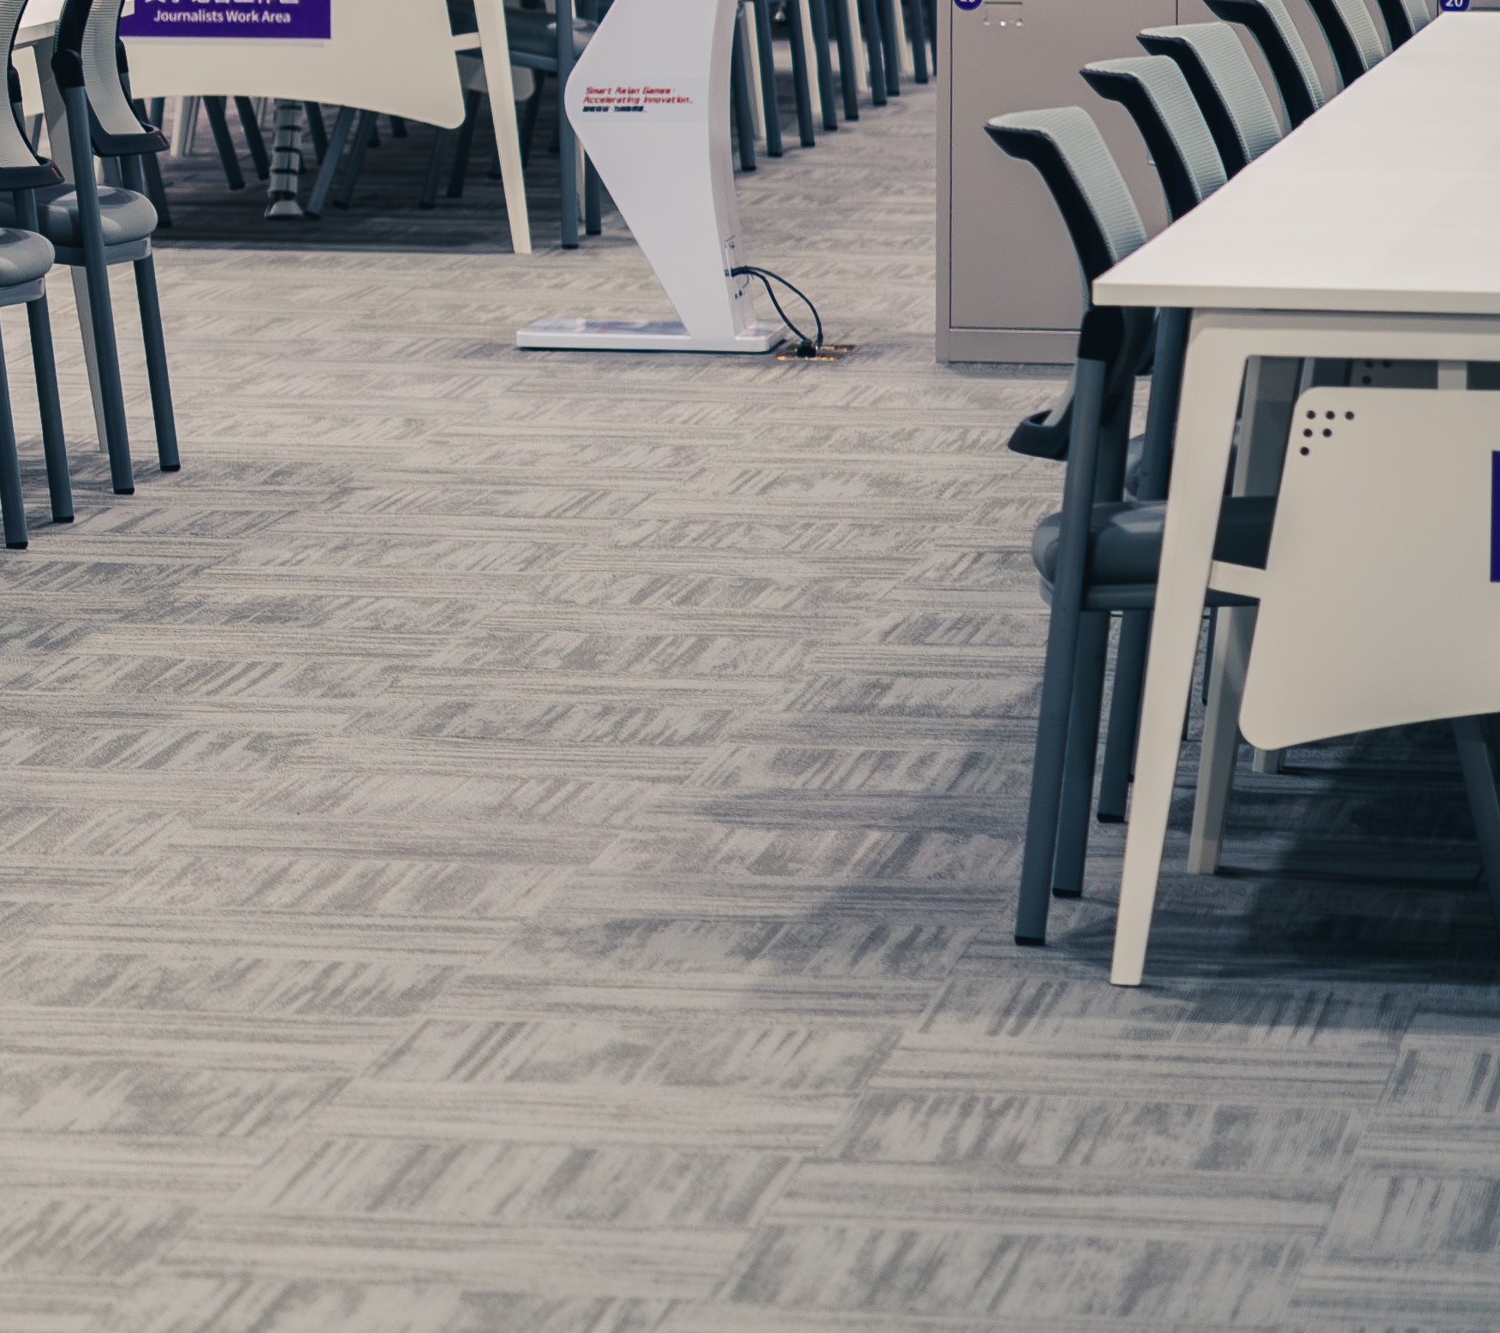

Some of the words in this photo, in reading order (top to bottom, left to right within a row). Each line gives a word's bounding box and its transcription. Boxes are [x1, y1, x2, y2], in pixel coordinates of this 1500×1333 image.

[154, 9, 224, 23] Journalists
[226, 10, 260, 23] Work
[261, 10, 291, 24] Area
